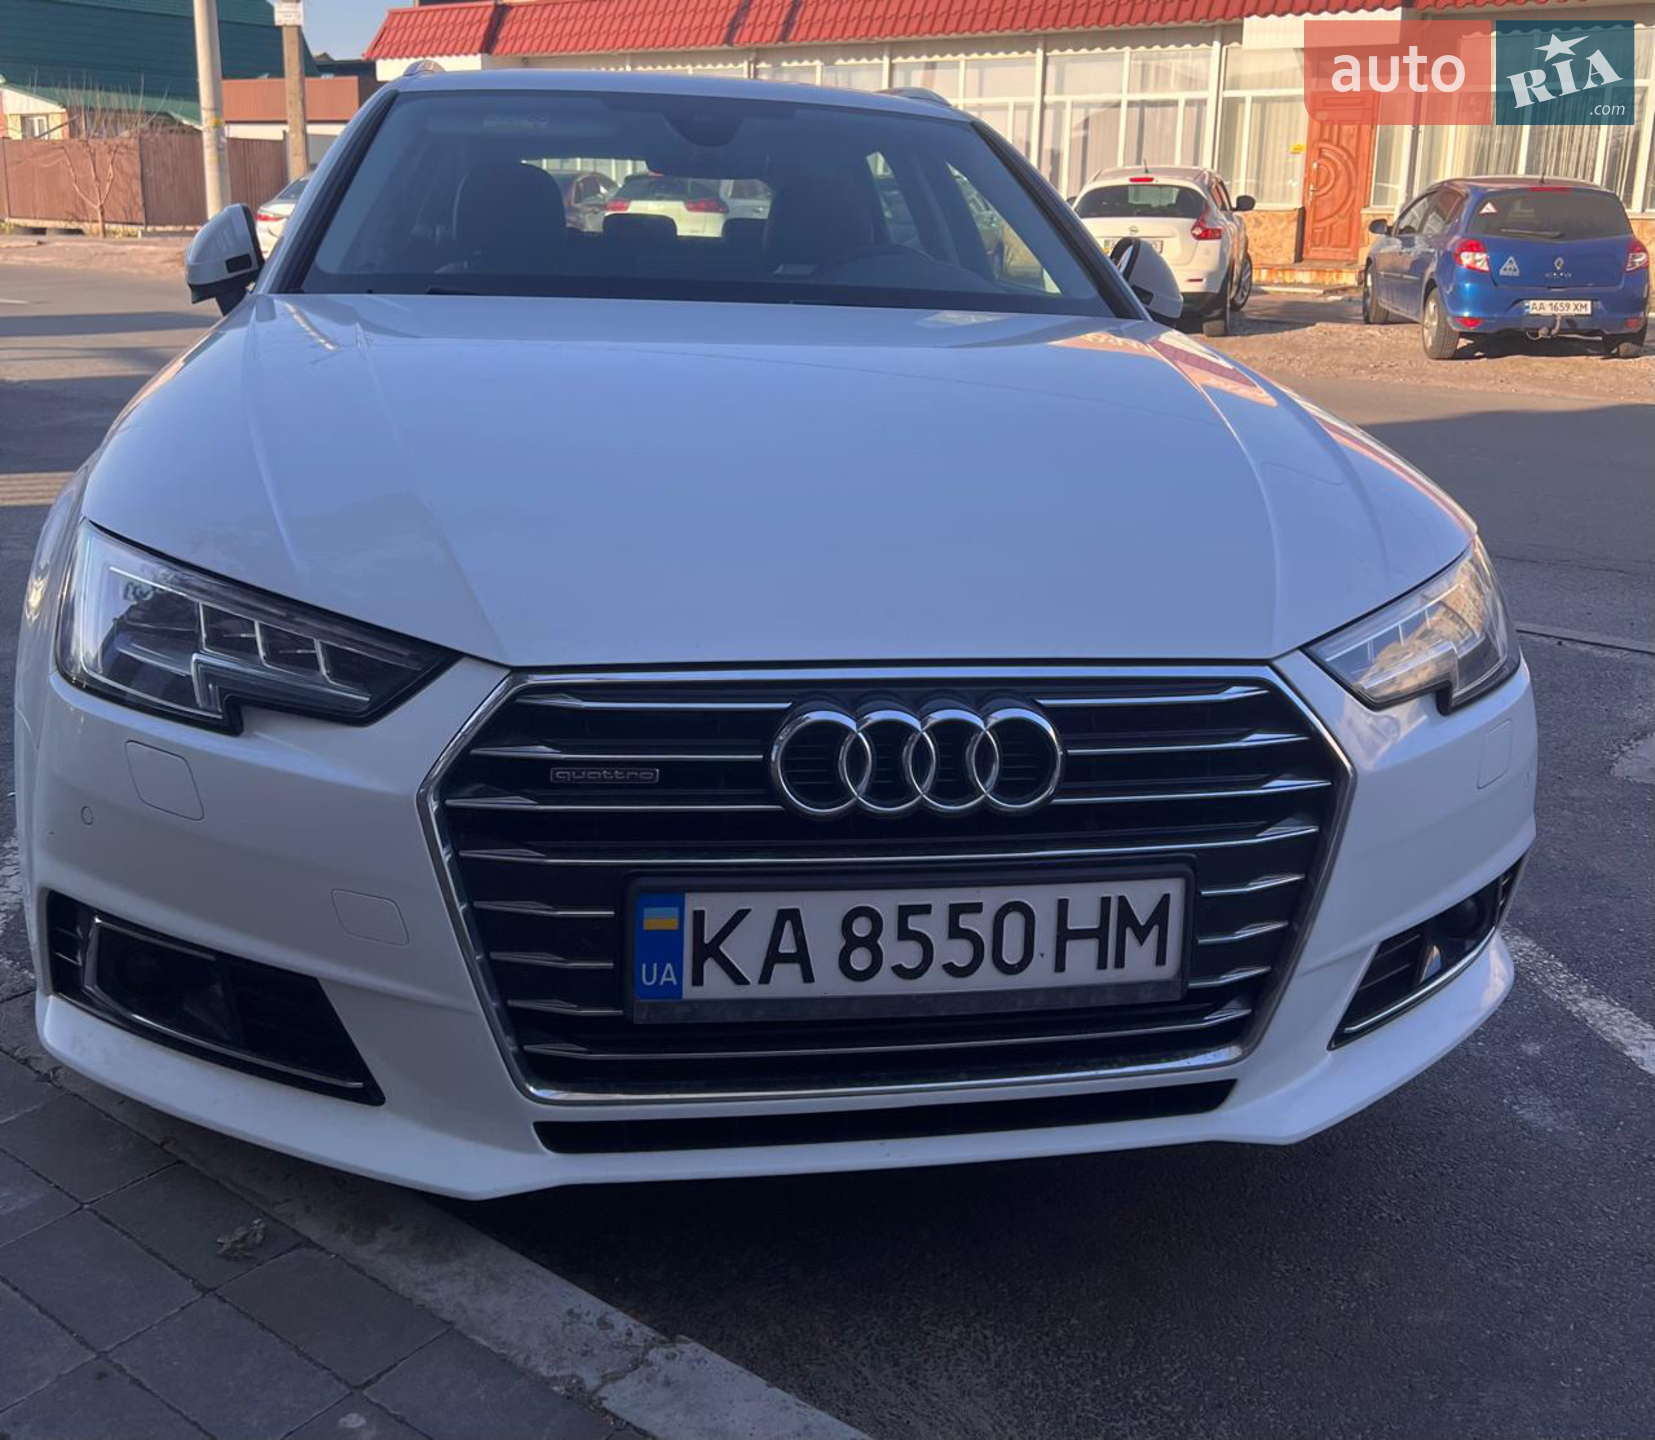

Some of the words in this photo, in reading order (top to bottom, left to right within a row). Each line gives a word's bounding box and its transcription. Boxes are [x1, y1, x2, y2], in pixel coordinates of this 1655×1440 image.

[1531, 302, 1546, 311] AA
[1549, 302, 1571, 312] 1659
[1573, 302, 1588, 312] XM
[555, 770, 654, 782] quattro
[691, 907, 815, 987] KA
[837, 900, 1036, 982] 8550
[1054, 893, 1171, 973] HM
[641, 962, 678, 986] UA
